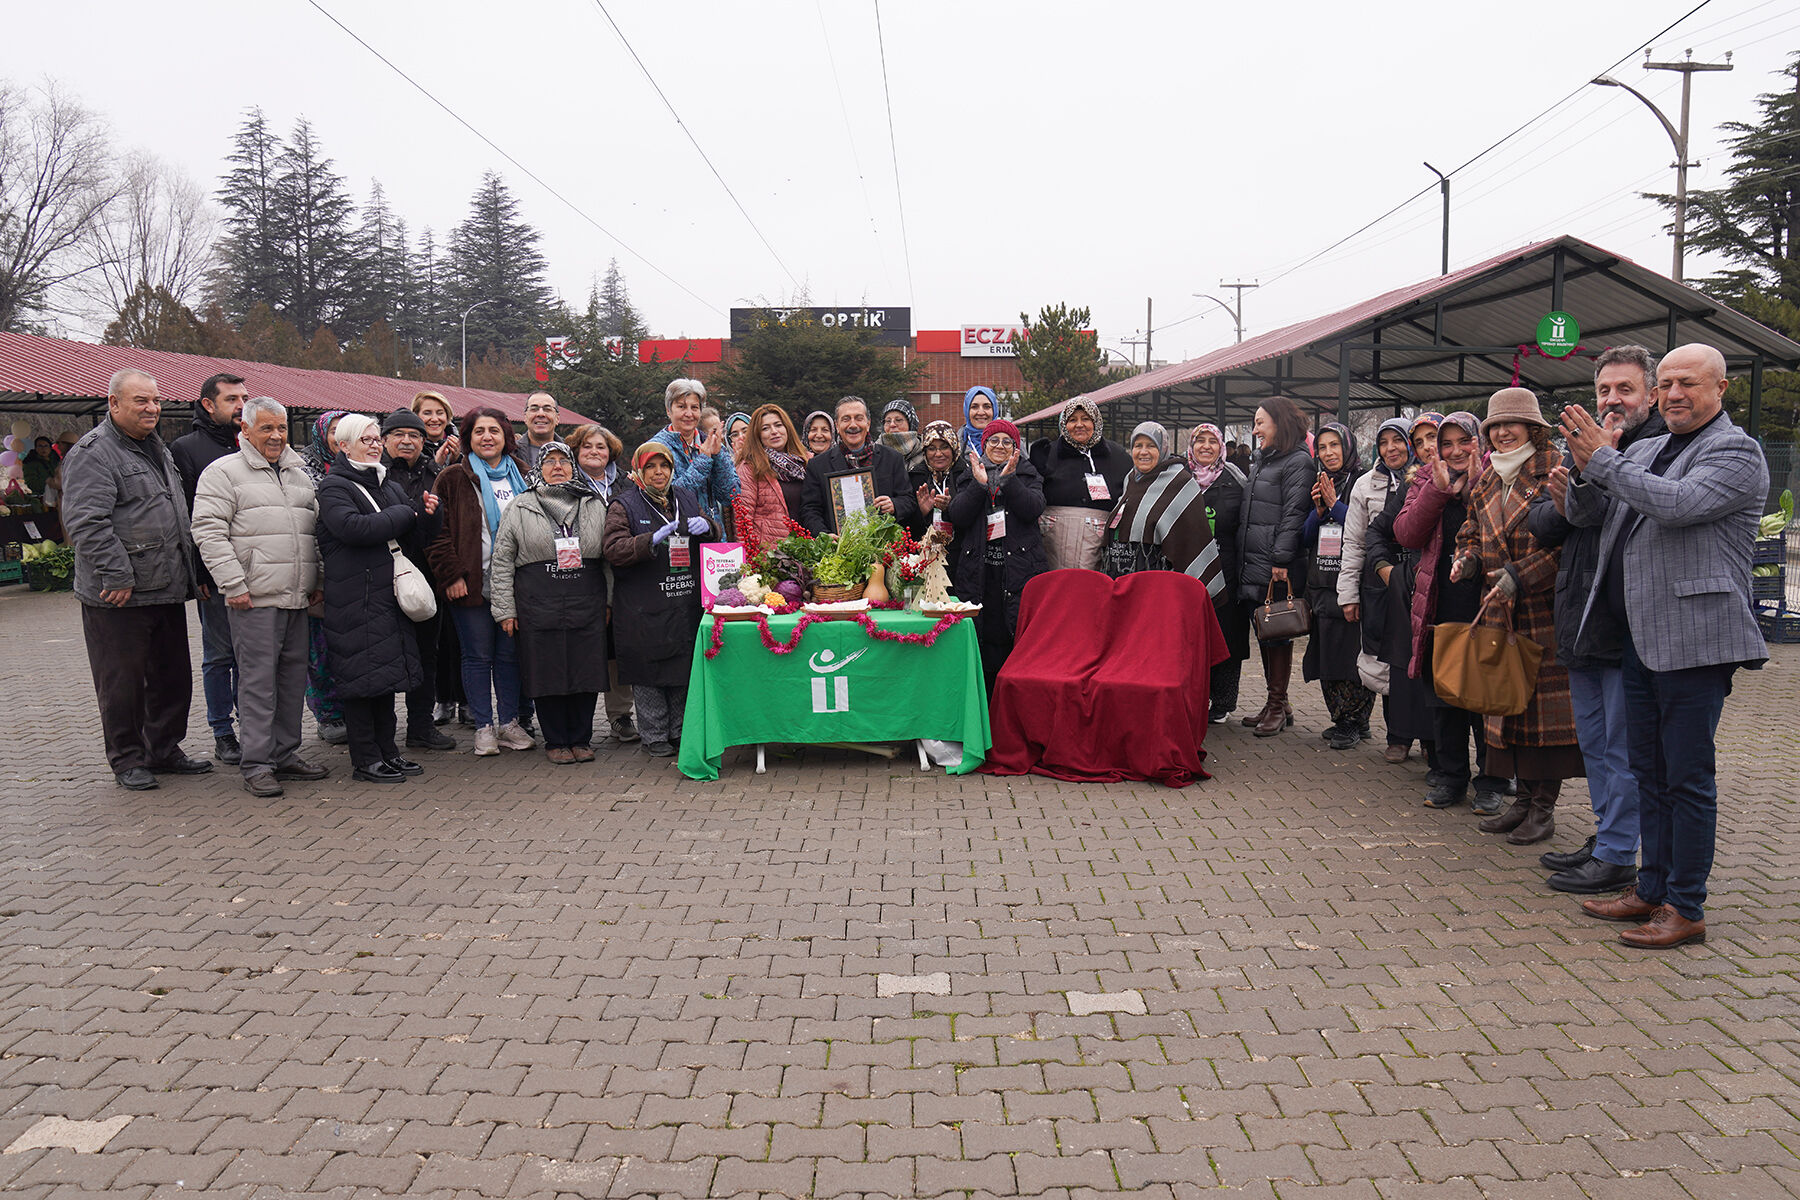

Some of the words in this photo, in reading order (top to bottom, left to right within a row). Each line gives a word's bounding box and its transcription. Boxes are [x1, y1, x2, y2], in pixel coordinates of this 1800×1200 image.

[821, 309, 882, 328] OPTİK
[1316, 557, 1342, 567] TEPEBAŞ
[658, 580, 695, 591] TEPEBAŞI
